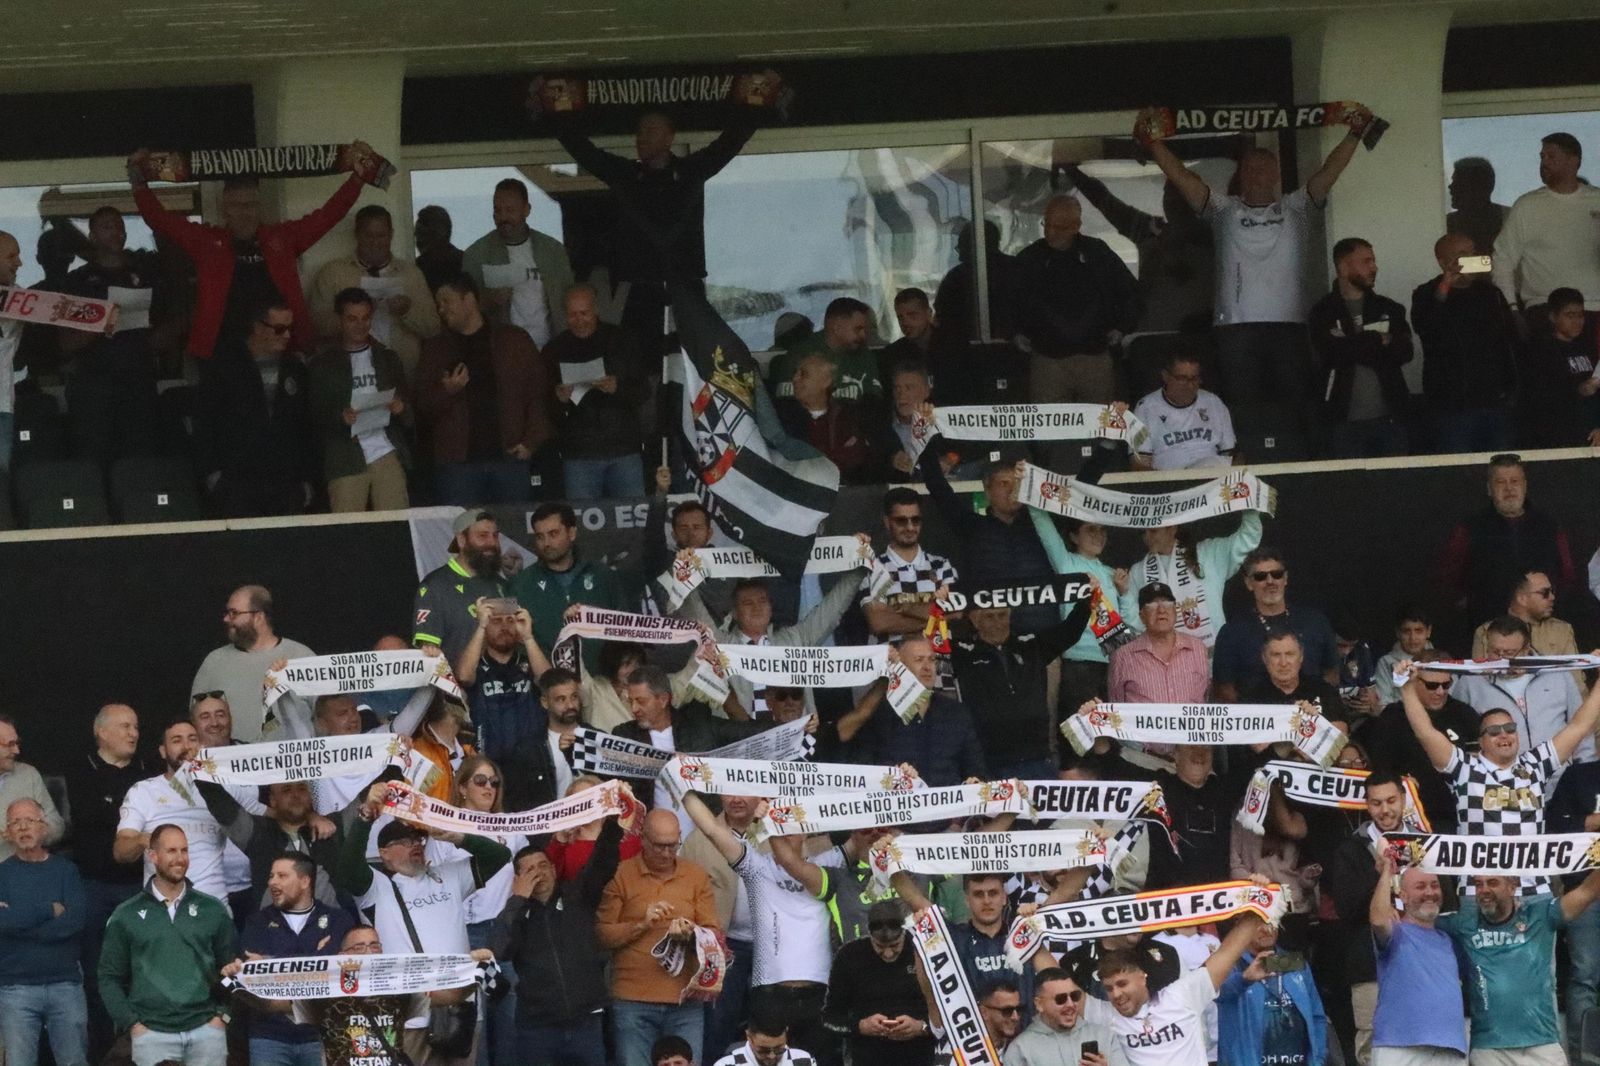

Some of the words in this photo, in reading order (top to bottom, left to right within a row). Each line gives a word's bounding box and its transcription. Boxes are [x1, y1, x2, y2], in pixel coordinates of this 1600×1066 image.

[587, 76, 734, 104] #BENDITALOCURA#
[1175, 109, 1206, 129] AD
[1213, 109, 1289, 129] CEUTA
[1295, 107, 1325, 127] FC
[191, 145, 338, 175] #BENDITALOCURA#
[4, 291, 39, 315] FC
[992, 405, 1039, 414] SIGAMOS
[947, 413, 1017, 428] HACIENDO
[1022, 413, 1085, 427] HISTORIA
[998, 428, 1035, 439] JUNTOS
[1163, 427, 1213, 447] CEUTA
[1083, 496, 1150, 517] HACIENDO
[1153, 494, 1208, 516] HISTORIA
[1129, 495, 1171, 506] SIGAMOS
[1127, 515, 1163, 526] JUNTOS
[808, 546, 844, 561] ORIA
[974, 586, 1057, 609] CEUTA
[1064, 582, 1092, 602] FC
[586, 612, 634, 628] ILUSION
[635, 615, 660, 629] NOS
[330, 653, 378, 666] SIGAMOS
[784, 648, 830, 659] SIGAMOS
[285, 665, 356, 682] HACIENDO
[361, 660, 425, 677] HISTORIA
[740, 658, 809, 674] HACIENDO
[812, 658, 875, 673] HISTORIA
[338, 679, 375, 692] JUNTOS
[790, 674, 826, 685] JUNTOS
[483, 680, 532, 698] CETA
[1182, 705, 1229, 717] SIGAMOS
[1135, 715, 1204, 731] HACIENDO
[1210, 716, 1275, 731] HISTORIA
[1187, 731, 1224, 742] JUNTOS
[278, 739, 326, 754] SIGAMOS
[230, 754, 303, 773] HACIENDO
[308, 745, 373, 765] HISTORIA
[284, 766, 322, 781] JUNTOS
[771, 762, 818, 773] SIGAMOS
[726, 768, 797, 785] HACIENDO
[801, 773, 867, 788] HISTORIA
[778, 785, 815, 797] JUNTOS
[1033, 785, 1100, 812] CEUTA
[1103, 787, 1133, 813] FC
[819, 799, 891, 818] HACIENDO
[897, 789, 964, 810] HISTORIA
[429, 802, 454, 818] UNA
[457, 811, 507, 825] ILUSION
[508, 813, 534, 825] NOS
[536, 800, 594, 823] PERSIGUE
[875, 810, 913, 825] JUNTOS
[962, 833, 1012, 845] SIGAMOS
[915, 845, 989, 862] HACIENDO
[995, 842, 1062, 859] HISTORIA
[1435, 841, 1467, 867] AD
[1471, 841, 1540, 869] CEUTA
[1543, 840, 1574, 869] FC
[970, 860, 1009, 872] JUNTOS
[1044, 910, 1095, 930] A.D.
[1101, 898, 1183, 925] CEUTA
[1190, 891, 1234, 914] F.C.
[242, 959, 329, 975] ASCENSO
[975, 954, 1010, 973] CEUT
[930, 951, 959, 1004] A.D.
[1126, 1023, 1185, 1049] CEUTA
